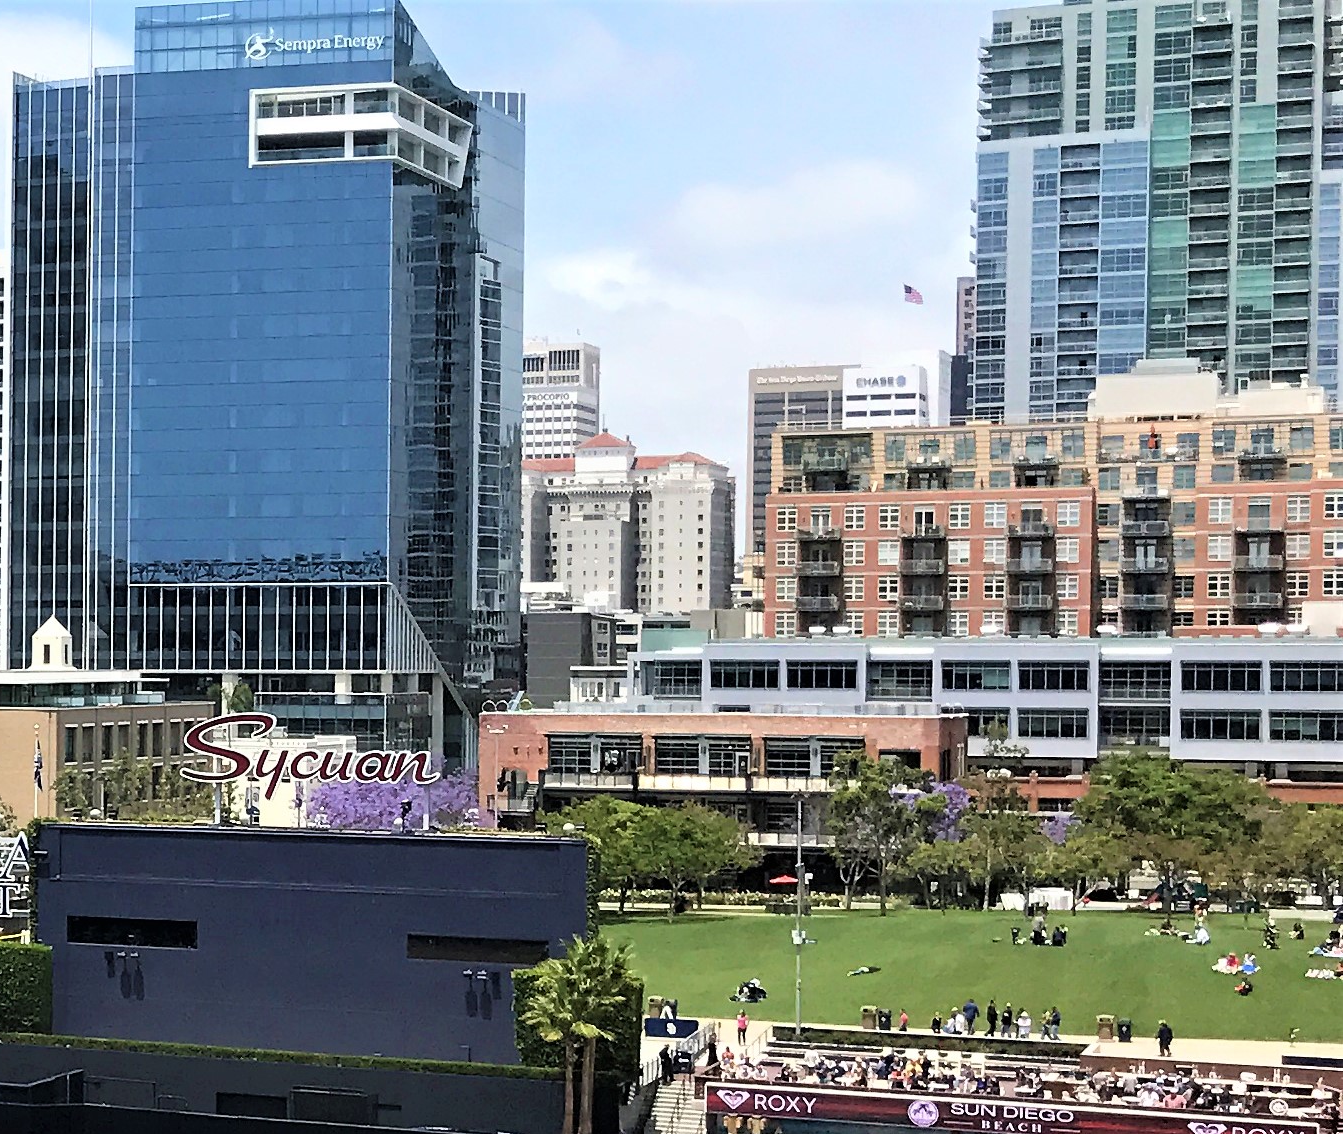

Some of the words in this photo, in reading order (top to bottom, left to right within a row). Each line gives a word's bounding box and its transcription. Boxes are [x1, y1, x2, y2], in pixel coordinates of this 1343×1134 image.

[275, 38, 331, 53] Sempra
[333, 34, 385, 50] Energy
[180, 711, 441, 801] Sycuan
[753, 1094, 817, 1115] ROXY
[950, 1102, 998, 1118] SUN
[1003, 1105, 1075, 1123] DIEGO
[981, 1119, 1042, 1134] BEACH
